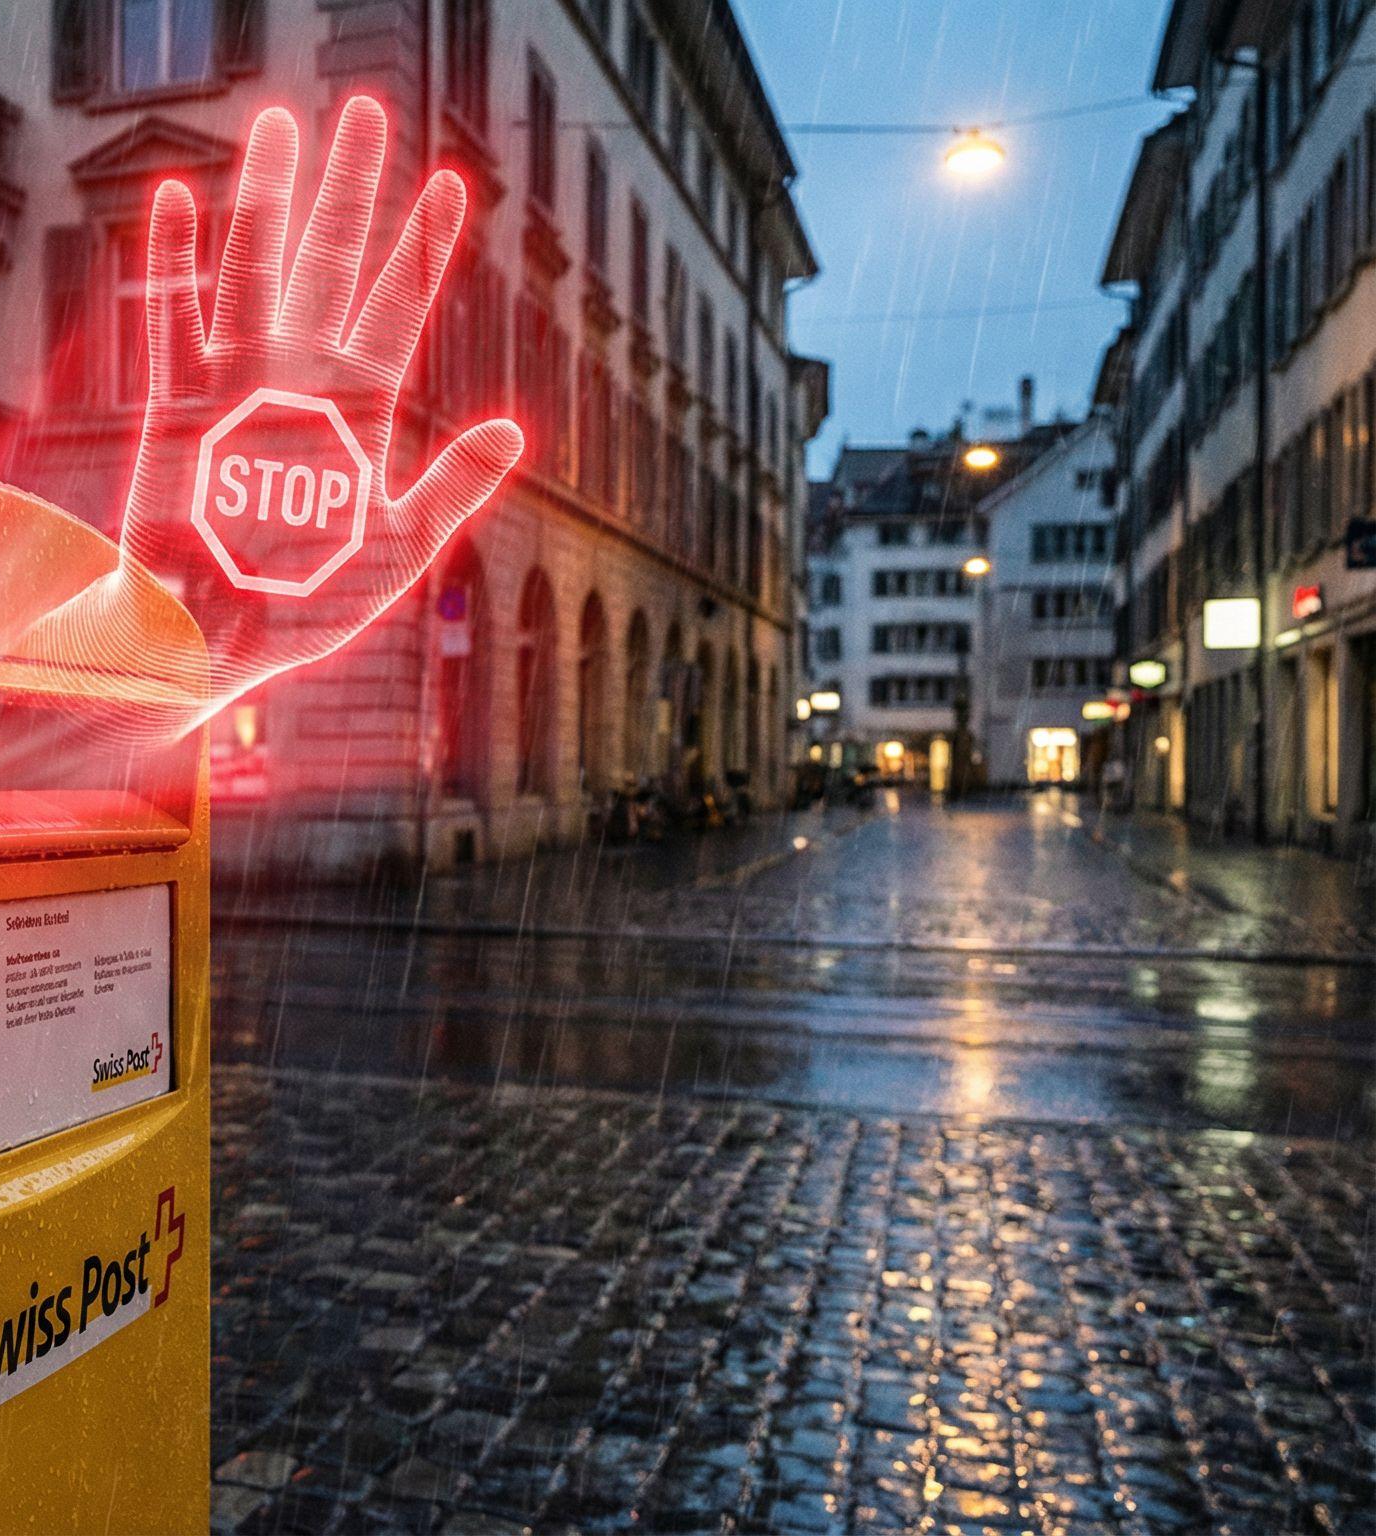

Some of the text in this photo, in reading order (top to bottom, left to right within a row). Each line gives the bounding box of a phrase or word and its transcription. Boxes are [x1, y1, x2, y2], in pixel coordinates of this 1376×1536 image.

[215, 454, 351, 529] STOP
[92, 1045, 150, 1084] Swiss Post
[78, 1231, 151, 1335] Post
